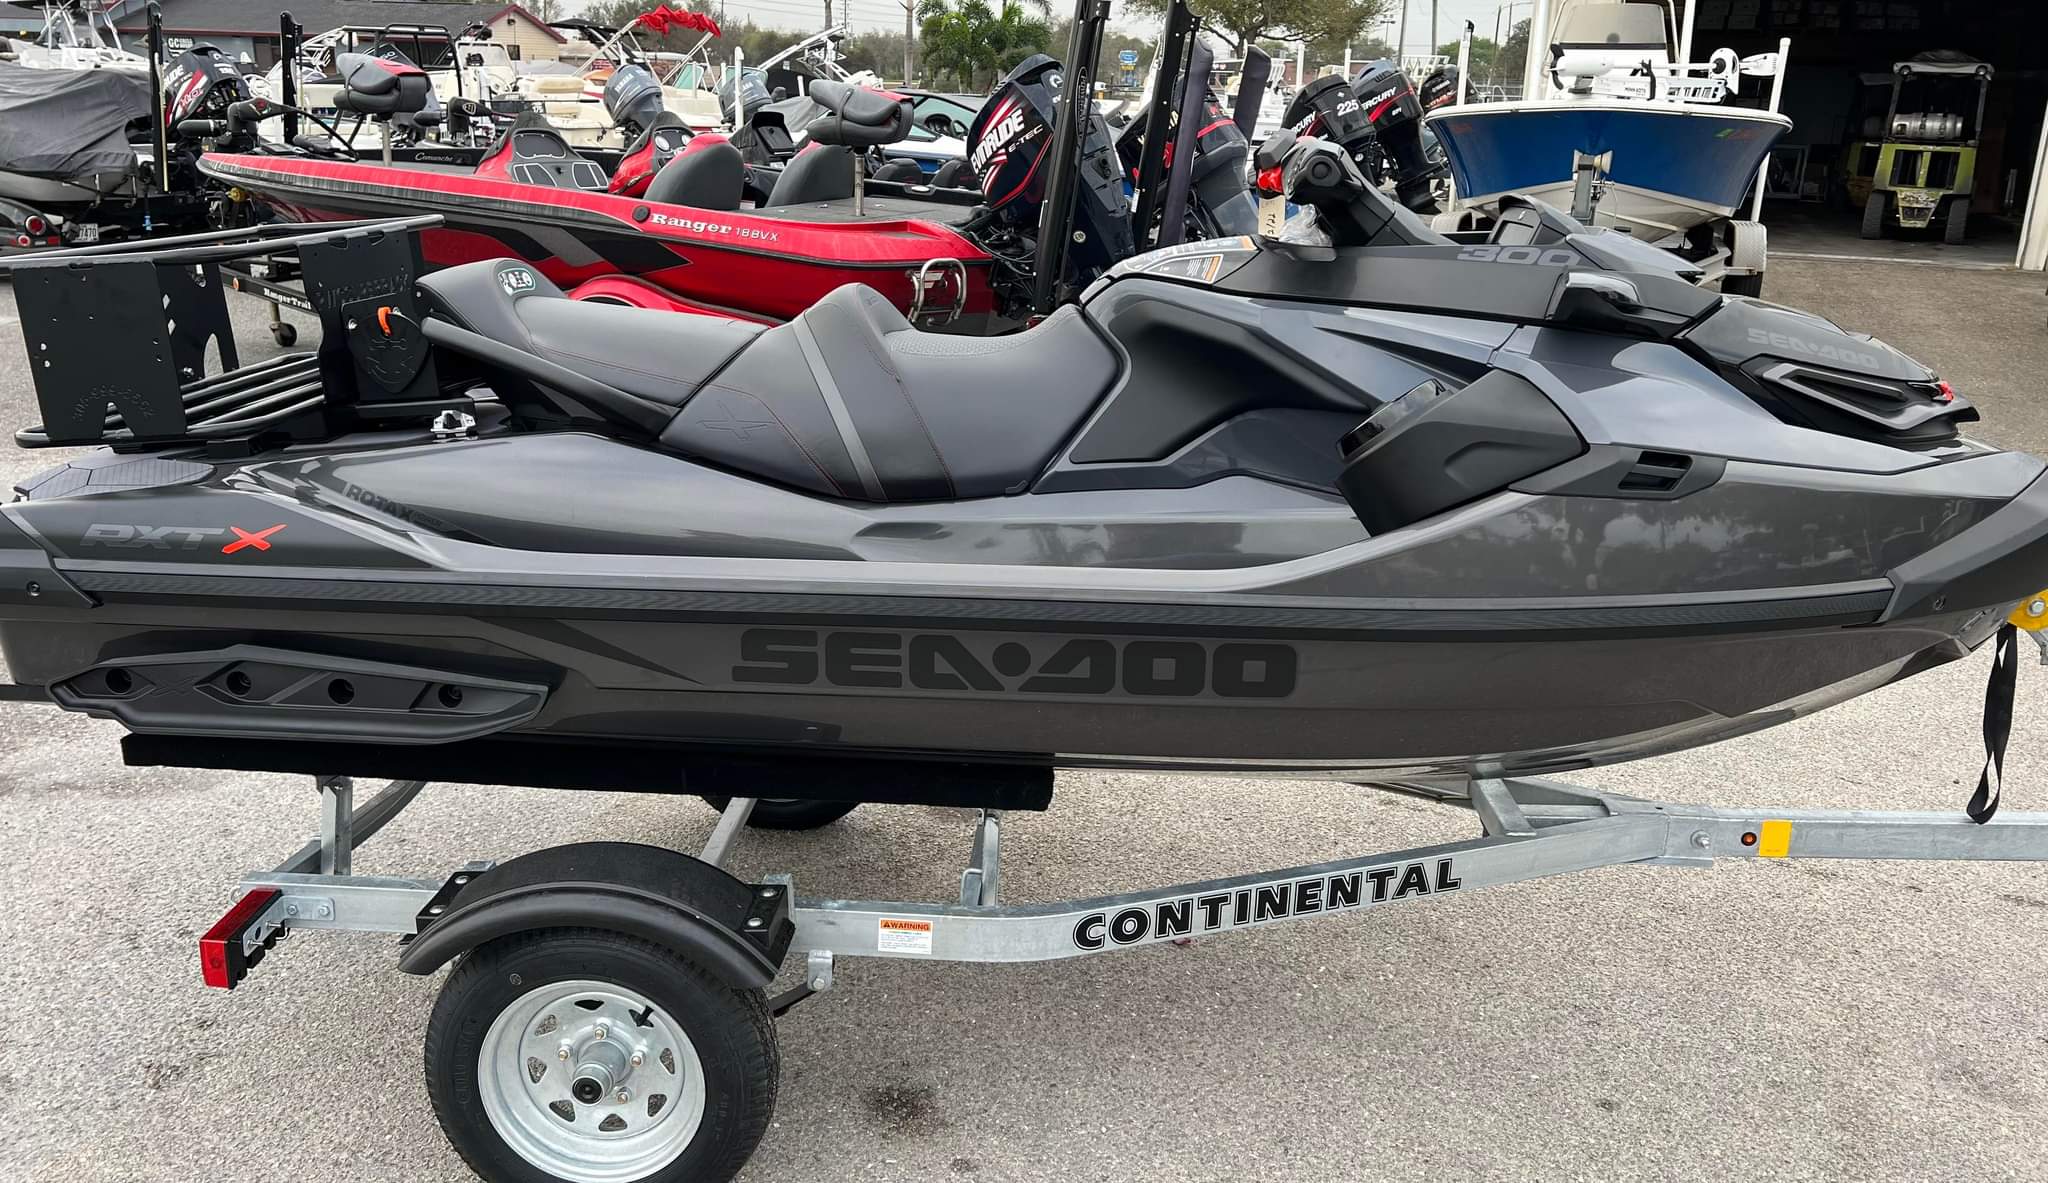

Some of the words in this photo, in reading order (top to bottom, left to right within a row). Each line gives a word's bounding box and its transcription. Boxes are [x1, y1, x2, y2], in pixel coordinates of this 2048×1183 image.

[1336, 99, 1360, 117] 225
[1008, 124, 1044, 153] E-TEC
[651, 213, 733, 234] Ranger
[735, 227, 779, 241] 188VX
[1457, 245, 1580, 267] 300
[346, 484, 411, 522] ROTAX
[222, 524, 288, 554] X
[1072, 858, 1462, 951] CONTINENTAL
[891, 921, 930, 931] WARNING
